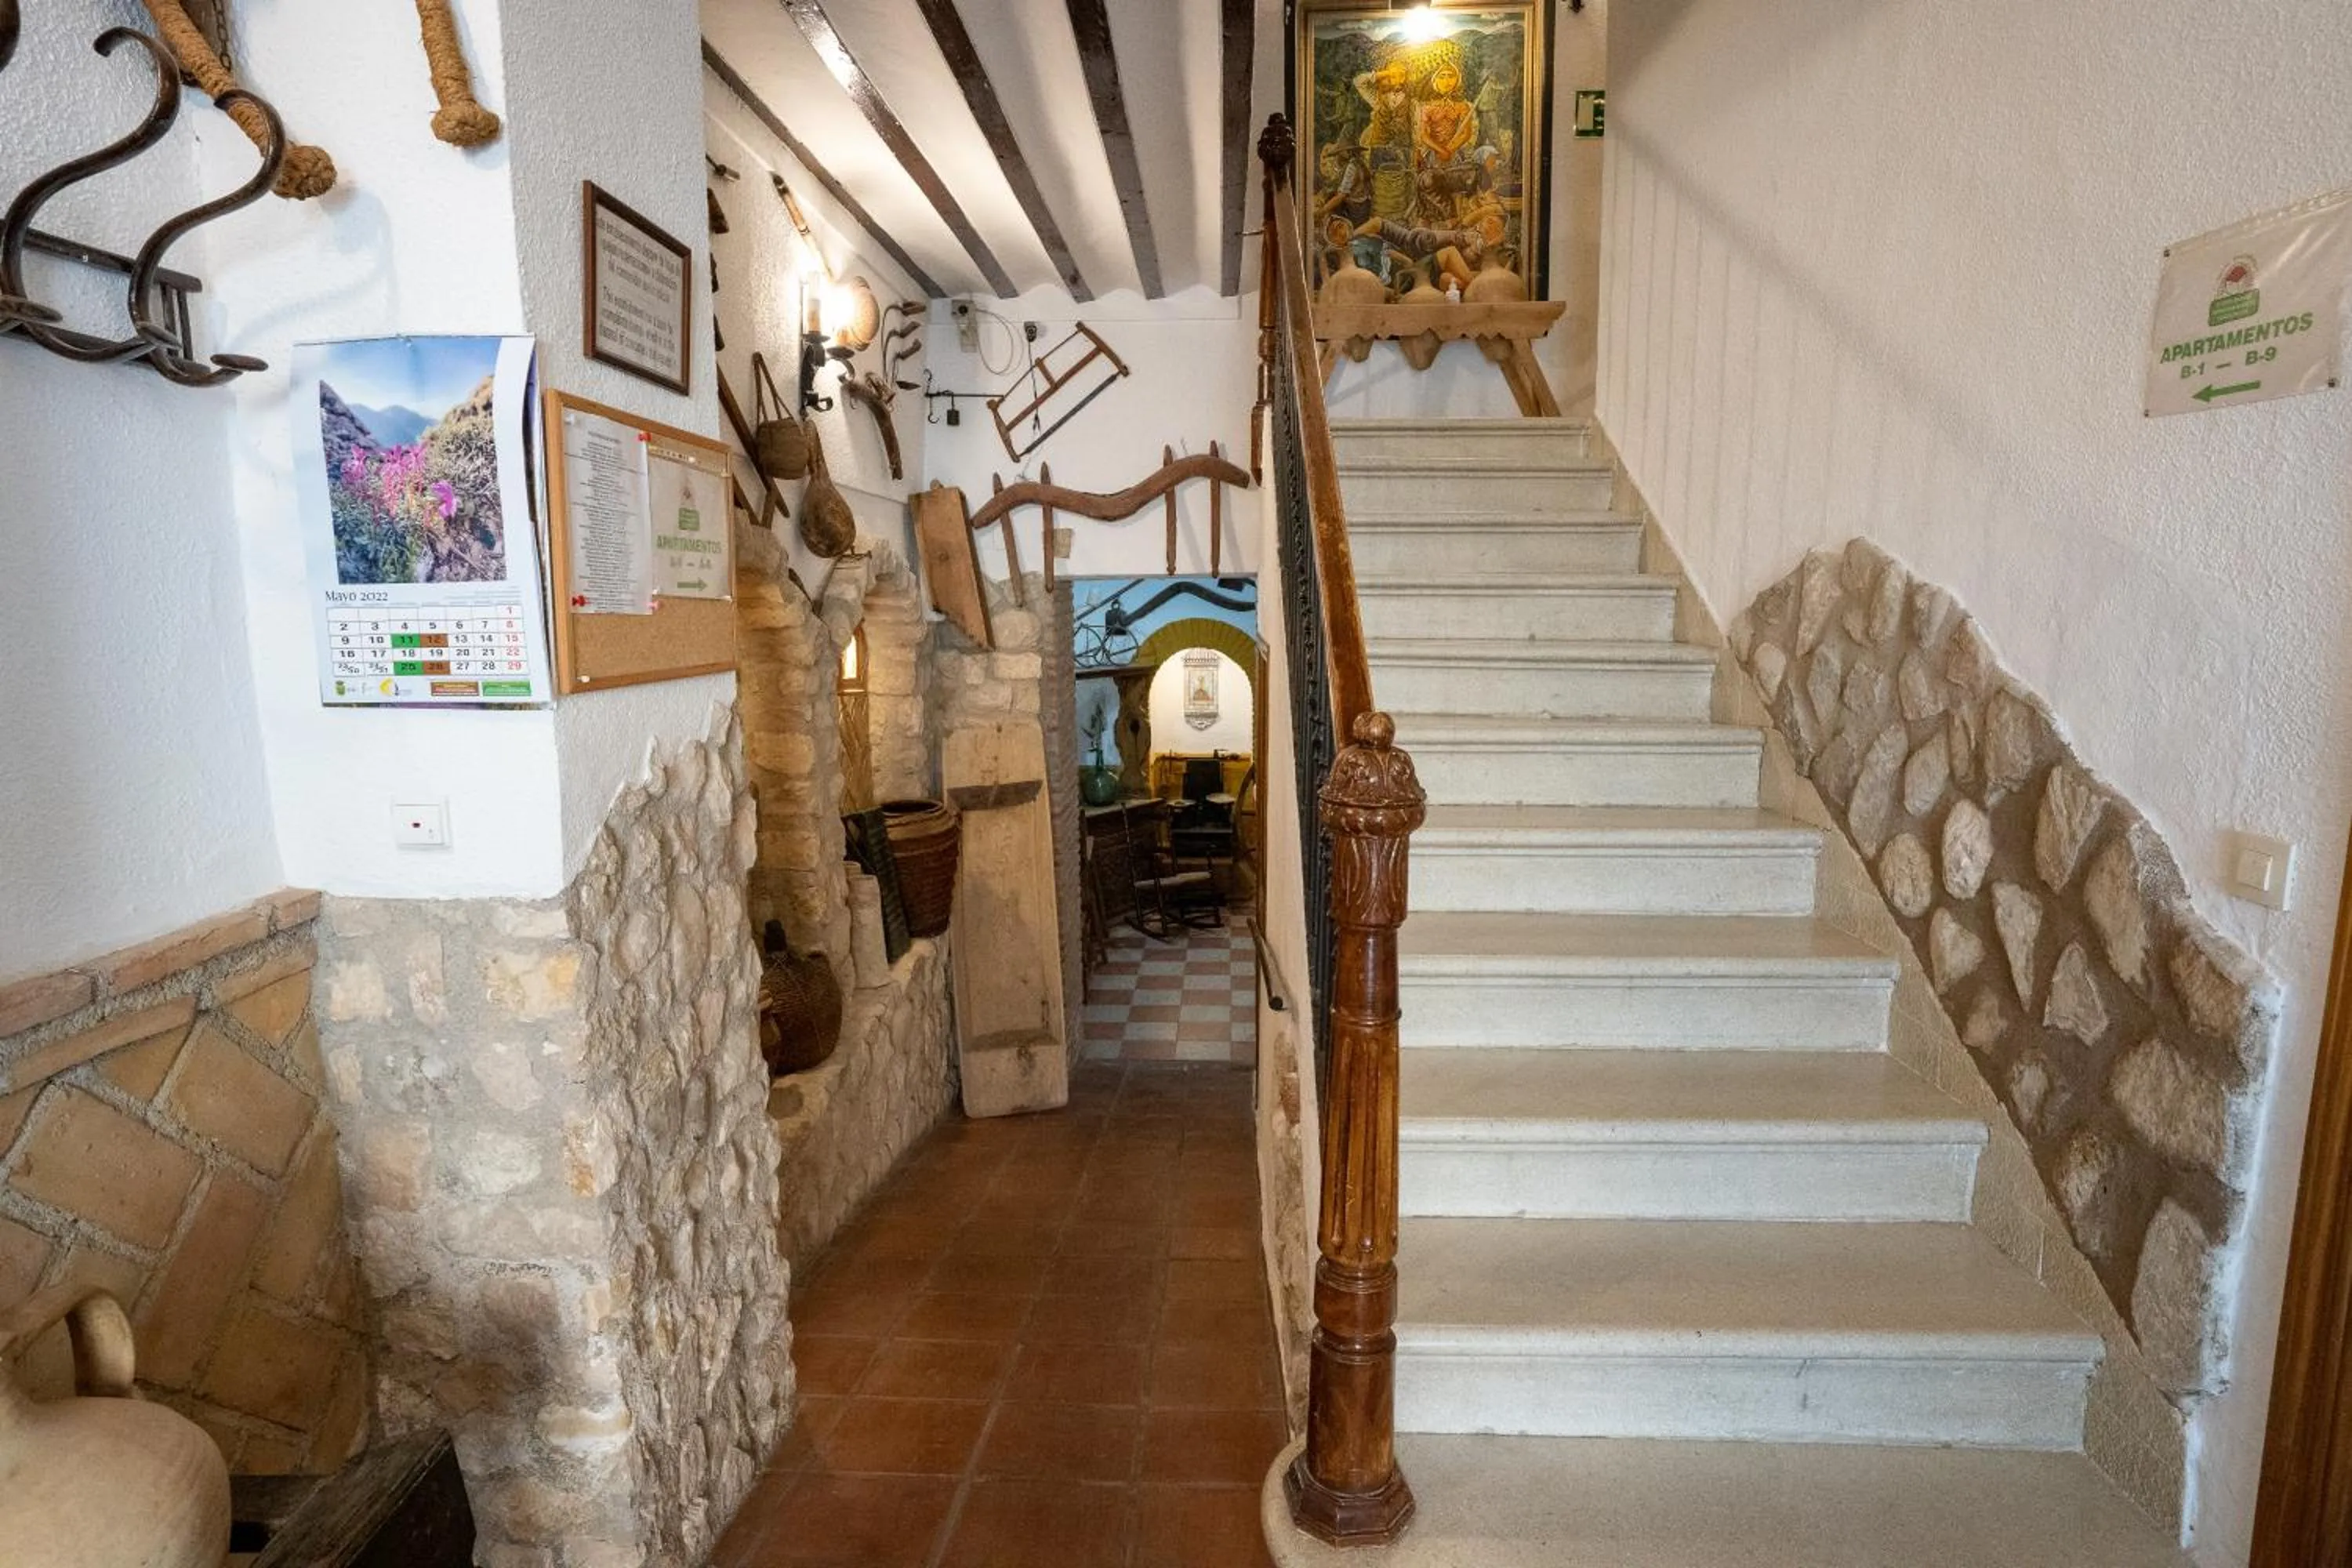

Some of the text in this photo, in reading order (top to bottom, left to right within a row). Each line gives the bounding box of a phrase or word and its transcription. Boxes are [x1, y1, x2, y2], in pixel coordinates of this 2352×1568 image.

[2159, 312, 2314, 364] APARTAMENTOS
[2180, 361, 2205, 379] B-1
[325, 590, 389, 603] Mayo 2022
[456, 621, 463, 630] 6
[341, 636, 350, 644] 9
[482, 662, 495, 670] 28
